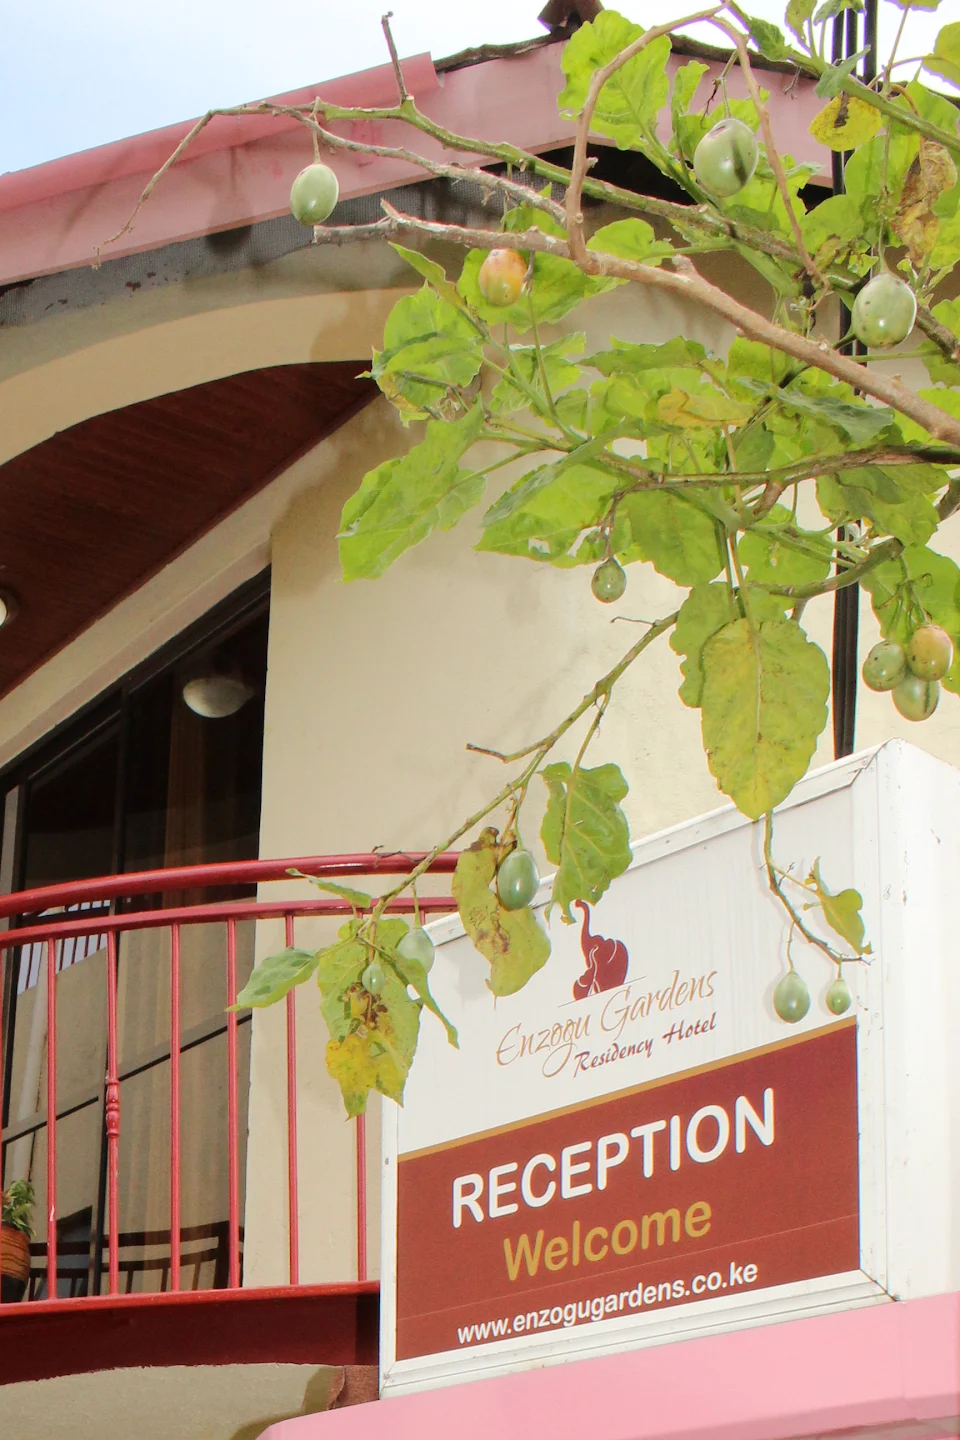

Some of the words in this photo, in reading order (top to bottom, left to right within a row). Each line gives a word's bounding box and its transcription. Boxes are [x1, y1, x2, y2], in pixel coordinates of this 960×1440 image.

[496, 1014, 591, 1078] Enzogu
[600, 970, 718, 1041] Gardens
[573, 1040, 654, 1078] Residency
[662, 1011, 717, 1045] Hotel
[452, 1087, 775, 1228] RECEPTION
[503, 1200, 712, 1281] Welcome
[457, 1261, 758, 1344] www.enzogugardens.co.ke
